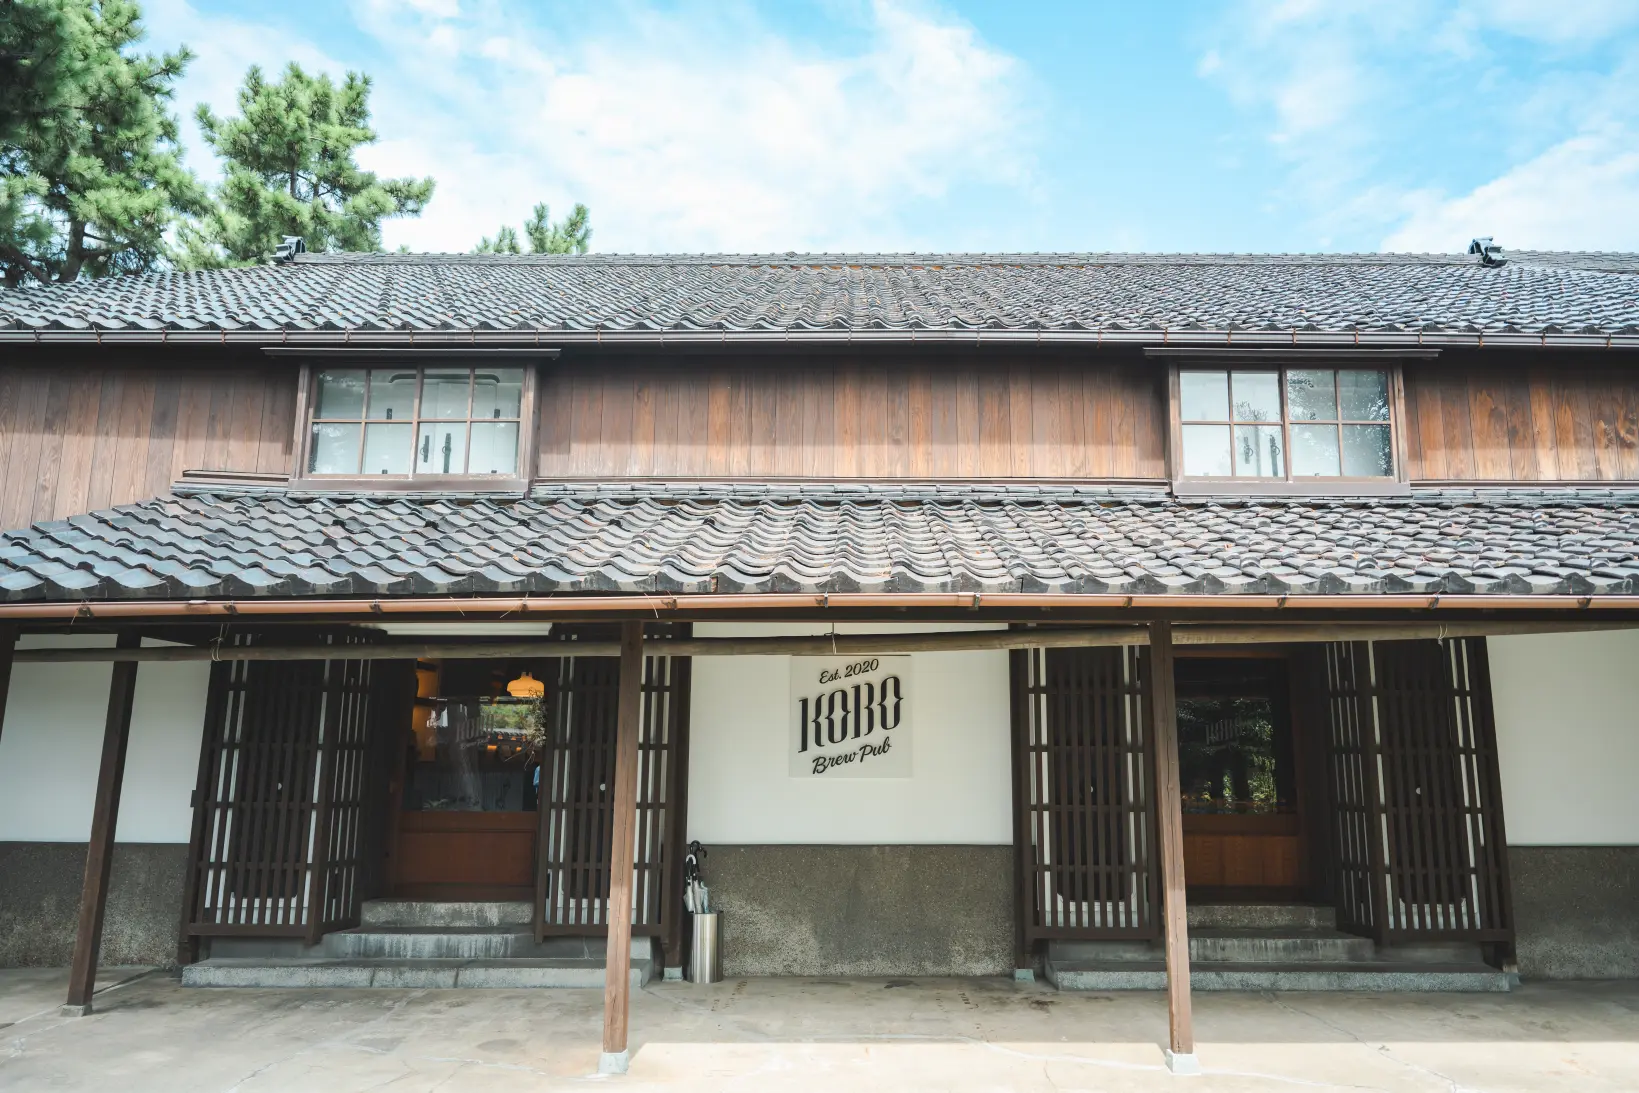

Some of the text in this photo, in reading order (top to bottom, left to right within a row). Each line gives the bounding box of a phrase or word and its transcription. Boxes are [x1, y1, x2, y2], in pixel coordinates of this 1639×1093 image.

[819, 658, 879, 684] Est. 2020
[798, 675, 904, 753] KOBO
[812, 736, 892, 774] Brew Pub
